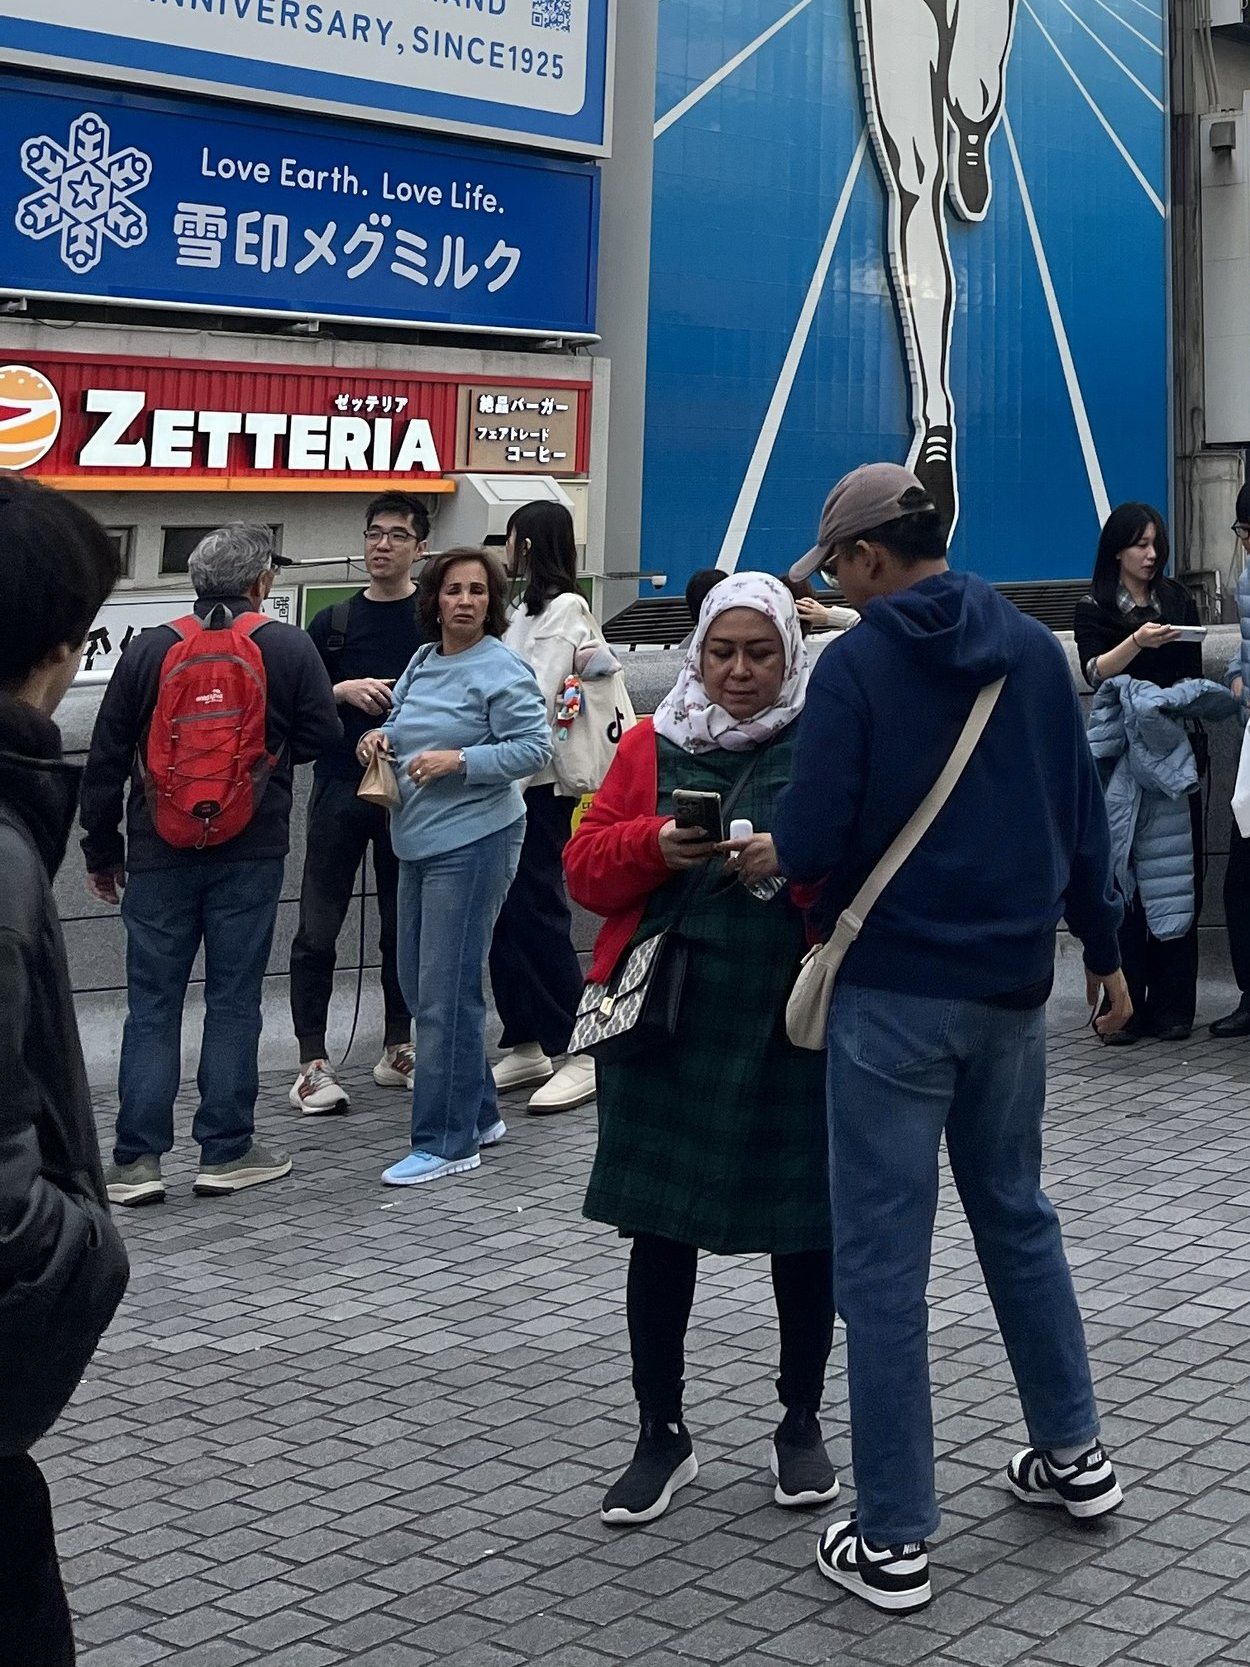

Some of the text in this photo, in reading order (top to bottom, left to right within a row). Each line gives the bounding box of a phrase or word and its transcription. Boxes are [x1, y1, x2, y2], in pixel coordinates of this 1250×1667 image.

[201, 147, 505, 215] Love Earth. Love Life.
[173, 201, 523, 293] 雪印メグミルク
[334, 394, 409, 414] ゼッテリア
[479, 395, 569, 415] 絶品バーガー
[79, 389, 441, 472] ZETTERIA
[477, 427, 550, 441] フェアトレード
[507, 445, 567, 463] コーヒー
